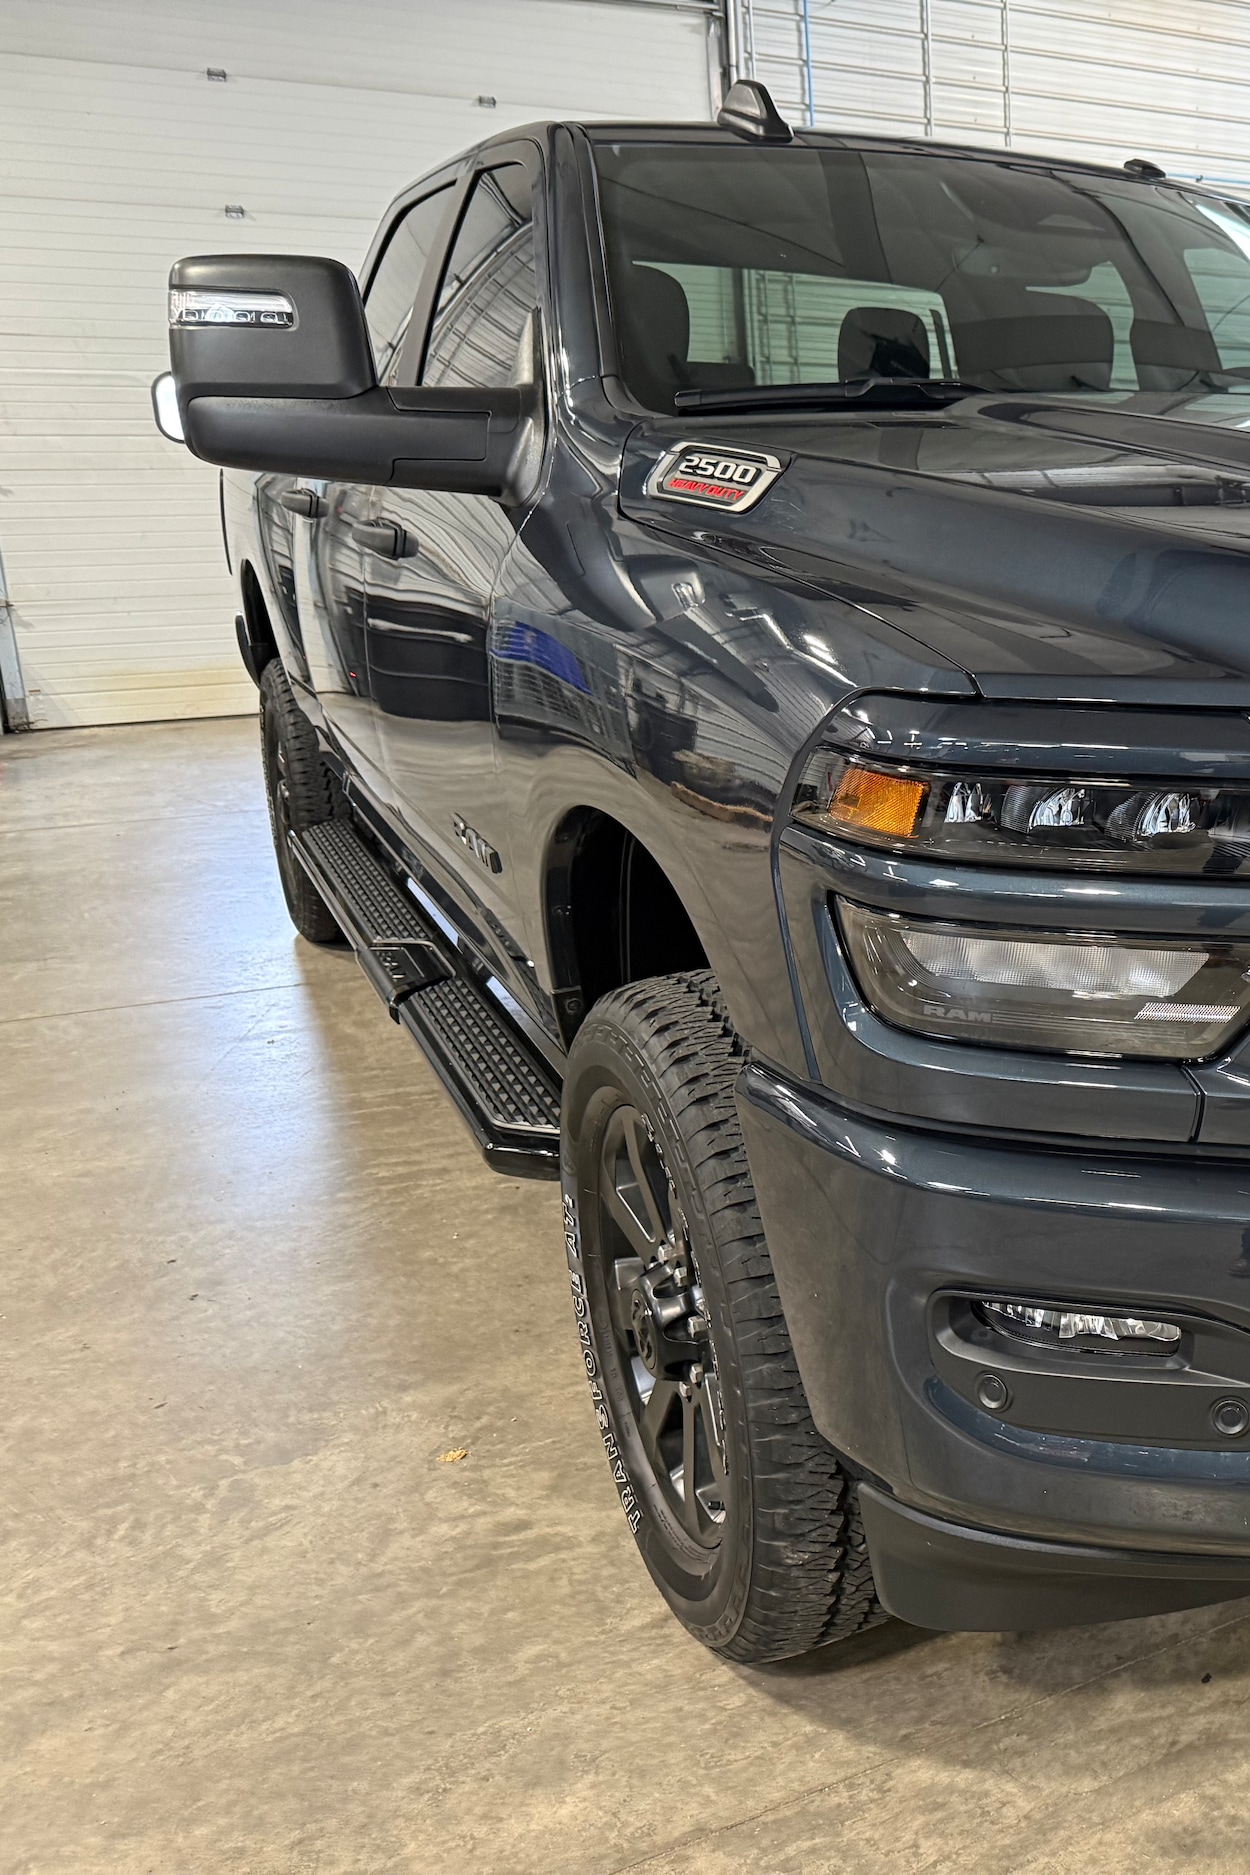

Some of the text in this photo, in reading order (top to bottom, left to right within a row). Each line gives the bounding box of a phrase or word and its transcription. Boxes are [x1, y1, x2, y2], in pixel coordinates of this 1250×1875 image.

[678, 455, 757, 483] 2500
[668, 478, 745, 500] HEAVY DUTY
[923, 1005, 992, 1022] RAM
[568, 1270, 642, 1534] TRANSFORCE
